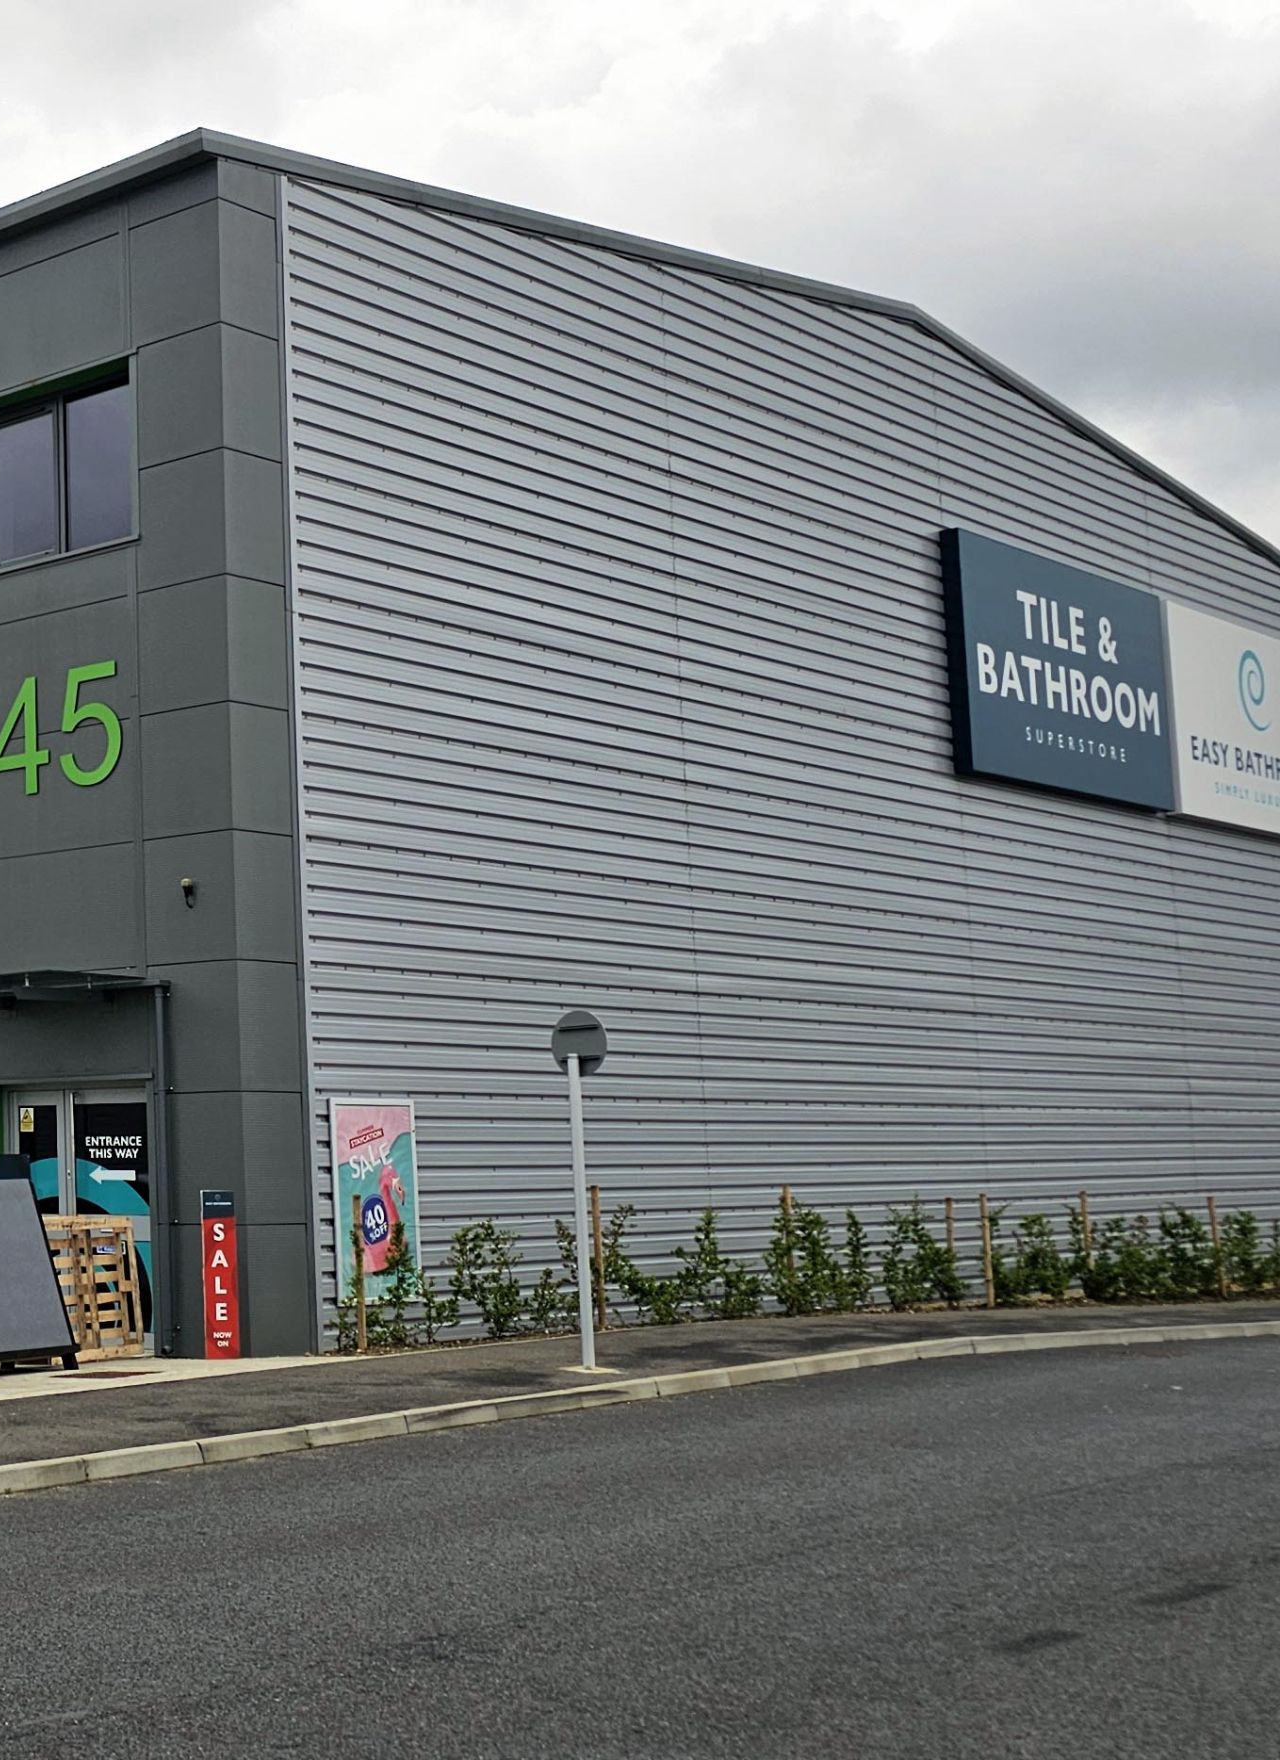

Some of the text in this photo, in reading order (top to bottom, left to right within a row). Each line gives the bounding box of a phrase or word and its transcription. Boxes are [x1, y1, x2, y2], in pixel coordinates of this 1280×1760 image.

[1016, 590, 1118, 664] TILE &
[976, 642, 1161, 736] BATHROOM
[1025, 726, 1127, 763] SUPERSTORE
[1191, 735, 1228, 768] EASY
[85, 1136, 142, 1147] ENTRANCE
[89, 1148, 139, 1159] THIS WAY
[350, 1142, 393, 1180] SALE
[365, 1204, 385, 1229] 40
[211, 1223, 229, 1321] SALE
[213, 1331, 232, 1339] NOW
